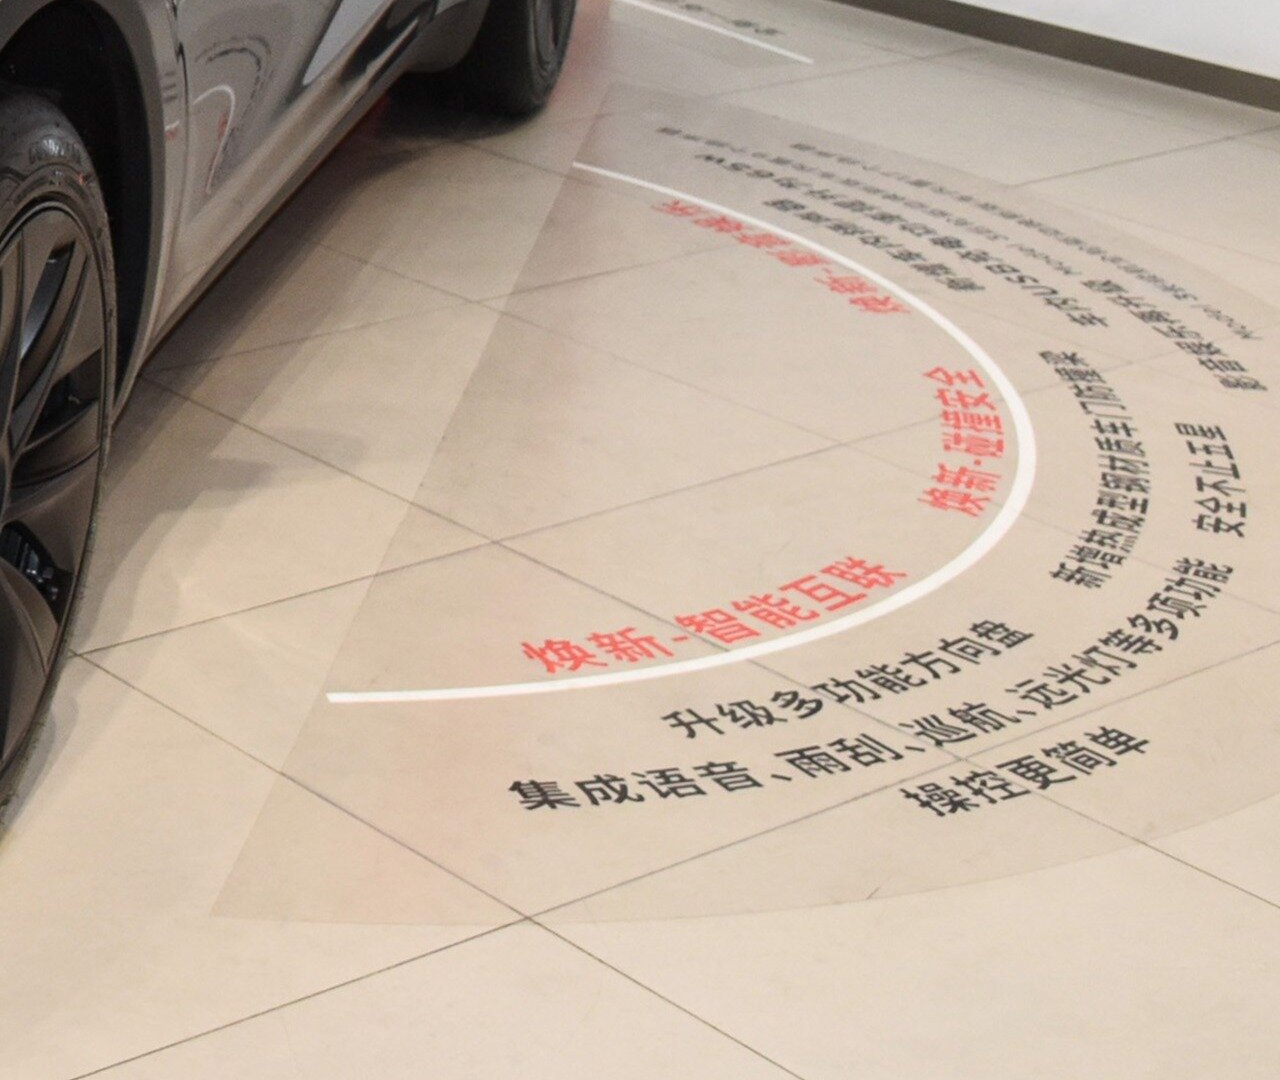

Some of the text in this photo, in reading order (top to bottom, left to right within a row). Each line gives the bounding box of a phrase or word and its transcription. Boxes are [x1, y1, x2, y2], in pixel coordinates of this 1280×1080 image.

[1039, 349, 1150, 589] 新增热成型钢材质车门防撞梁
[1175, 421, 1246, 537] 安全不止五星
[508, 555, 1234, 813] 集成语音、雨刮、巡航、远光灯等多项功能
[663, 619, 1033, 741] 升级多功能方向盘
[900, 725, 1154, 818] 操控更简单
